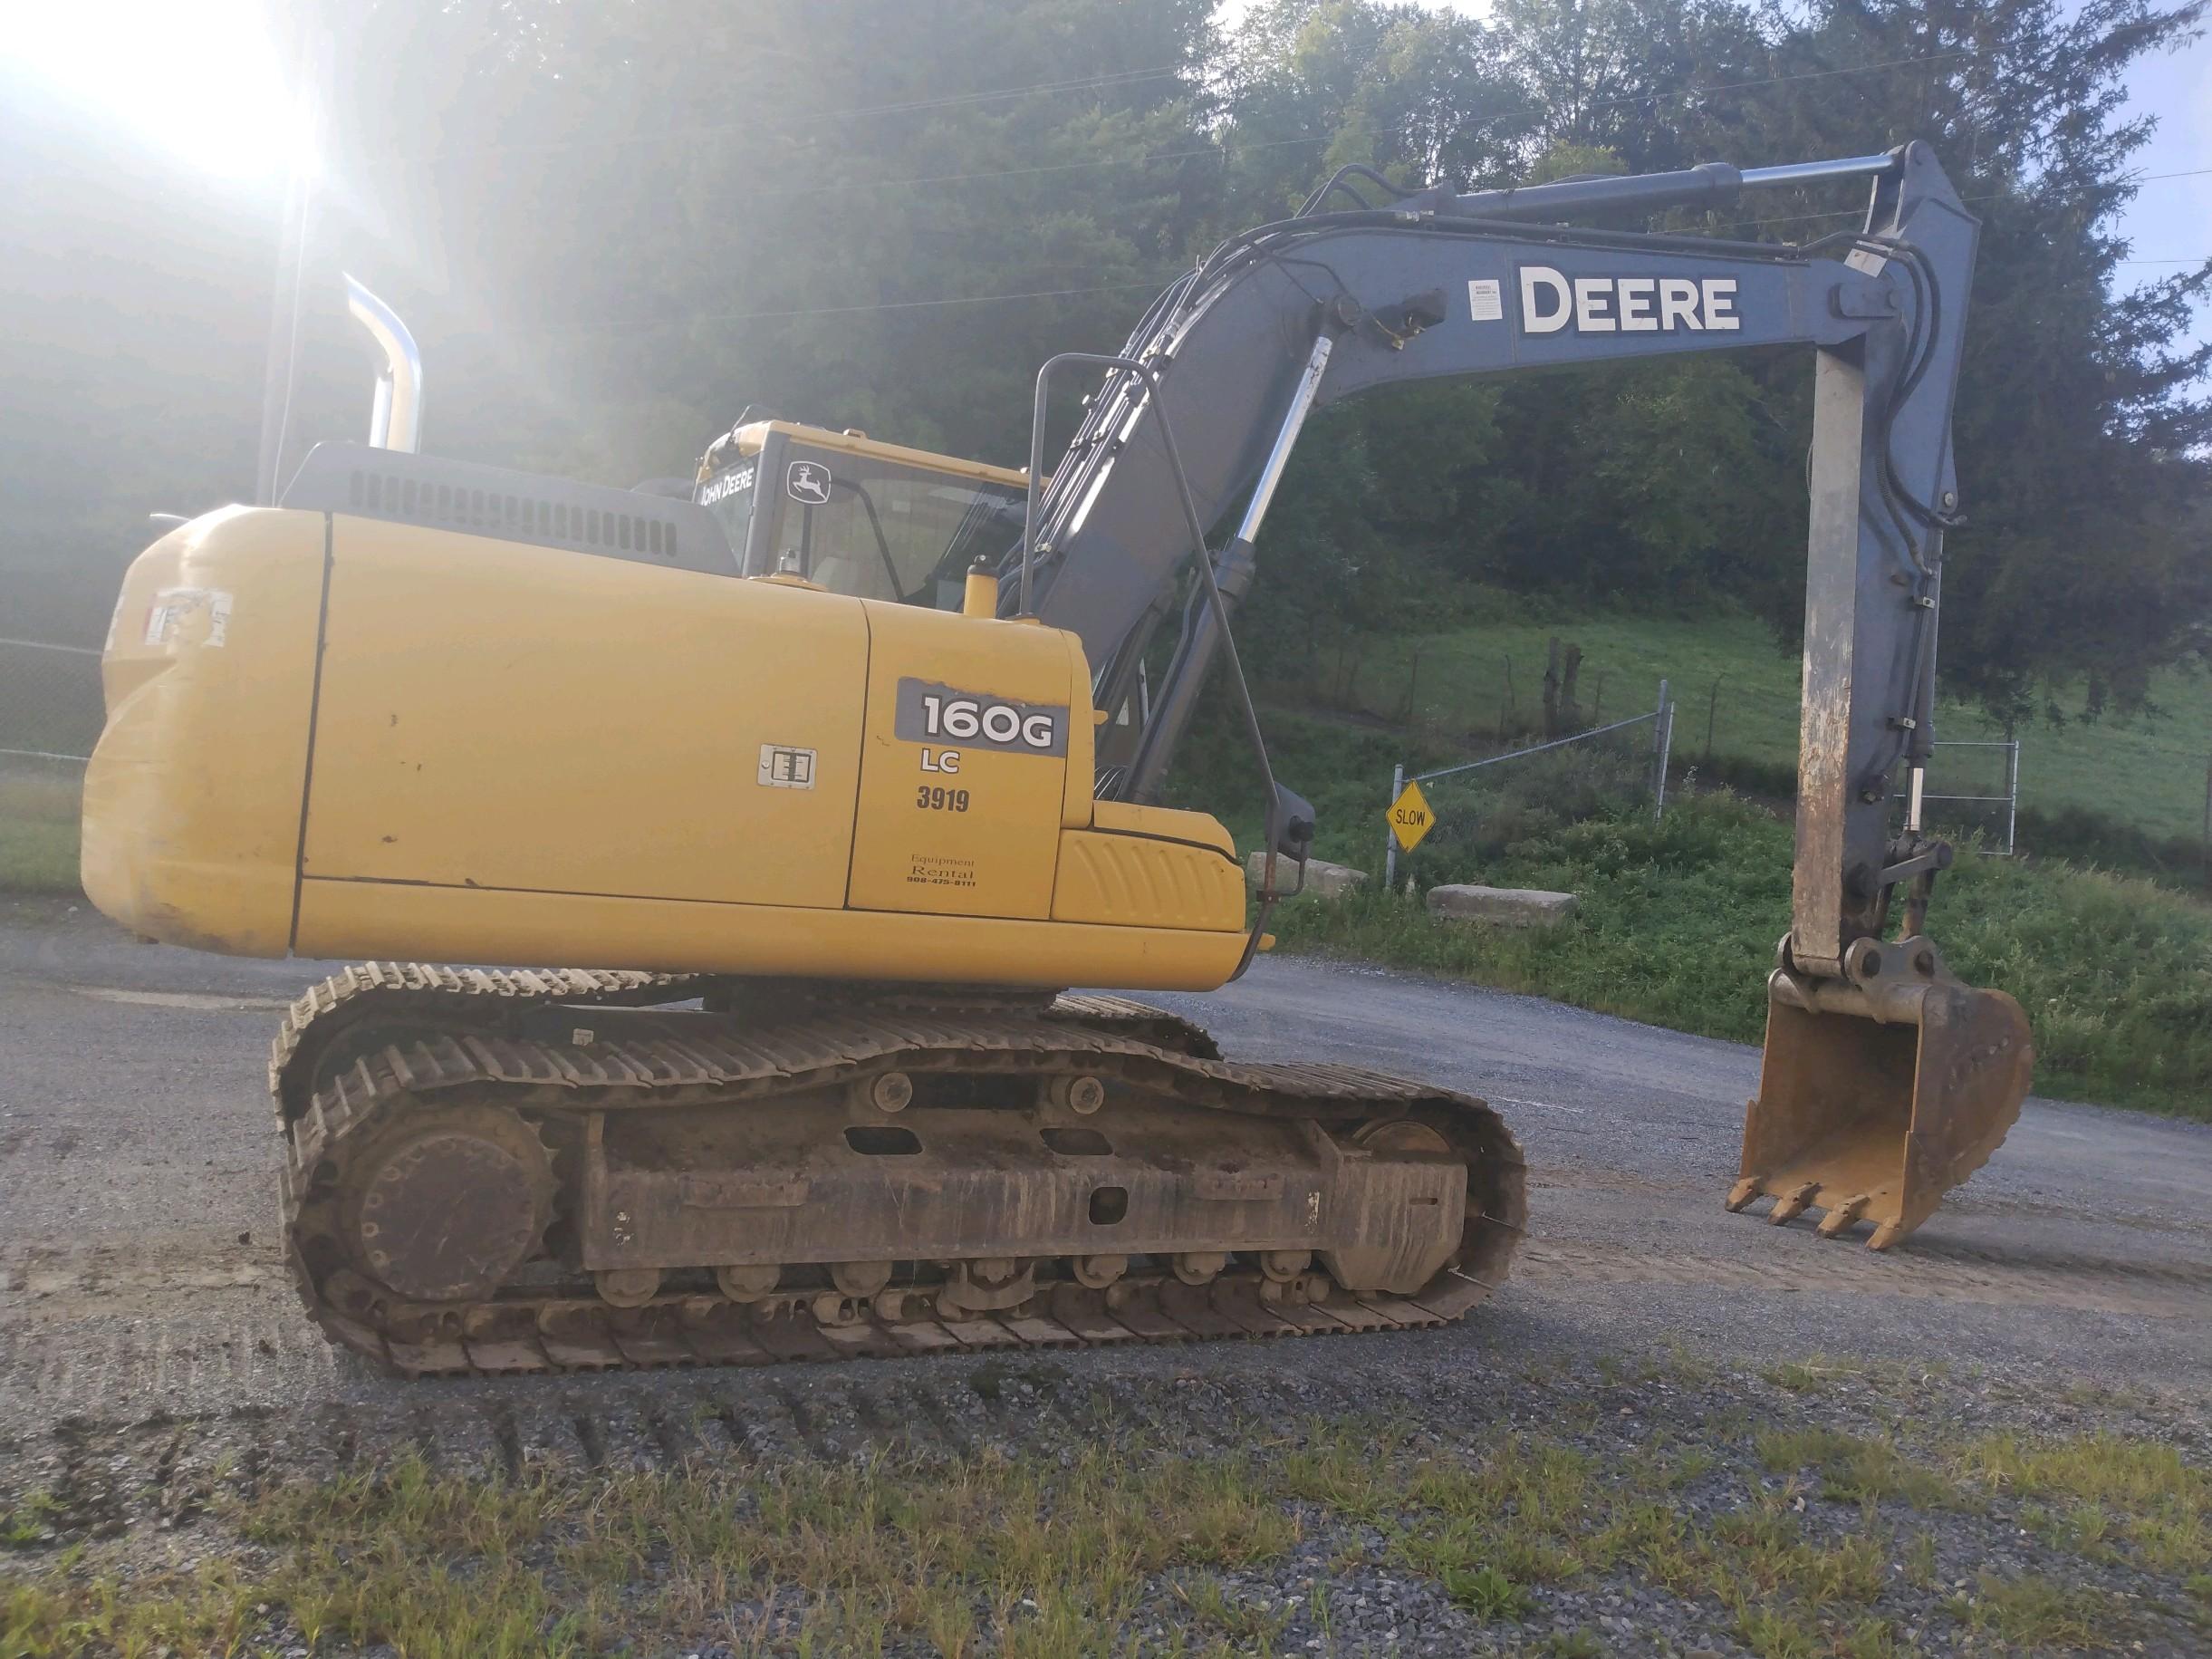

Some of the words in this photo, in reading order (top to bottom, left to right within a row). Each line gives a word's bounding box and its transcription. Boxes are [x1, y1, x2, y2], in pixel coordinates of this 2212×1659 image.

[1520, 266, 1740, 333] DEERE
[701, 481, 723, 506] JOHN
[722, 467, 755, 498] DEERE
[922, 695, 1053, 748] 160G
[920, 748, 960, 773] LC
[917, 786, 969, 812] 3919
[1396, 808, 1426, 826] SLOW
[911, 854, 975, 867] Equipment
[912, 865, 973, 879] Rental
